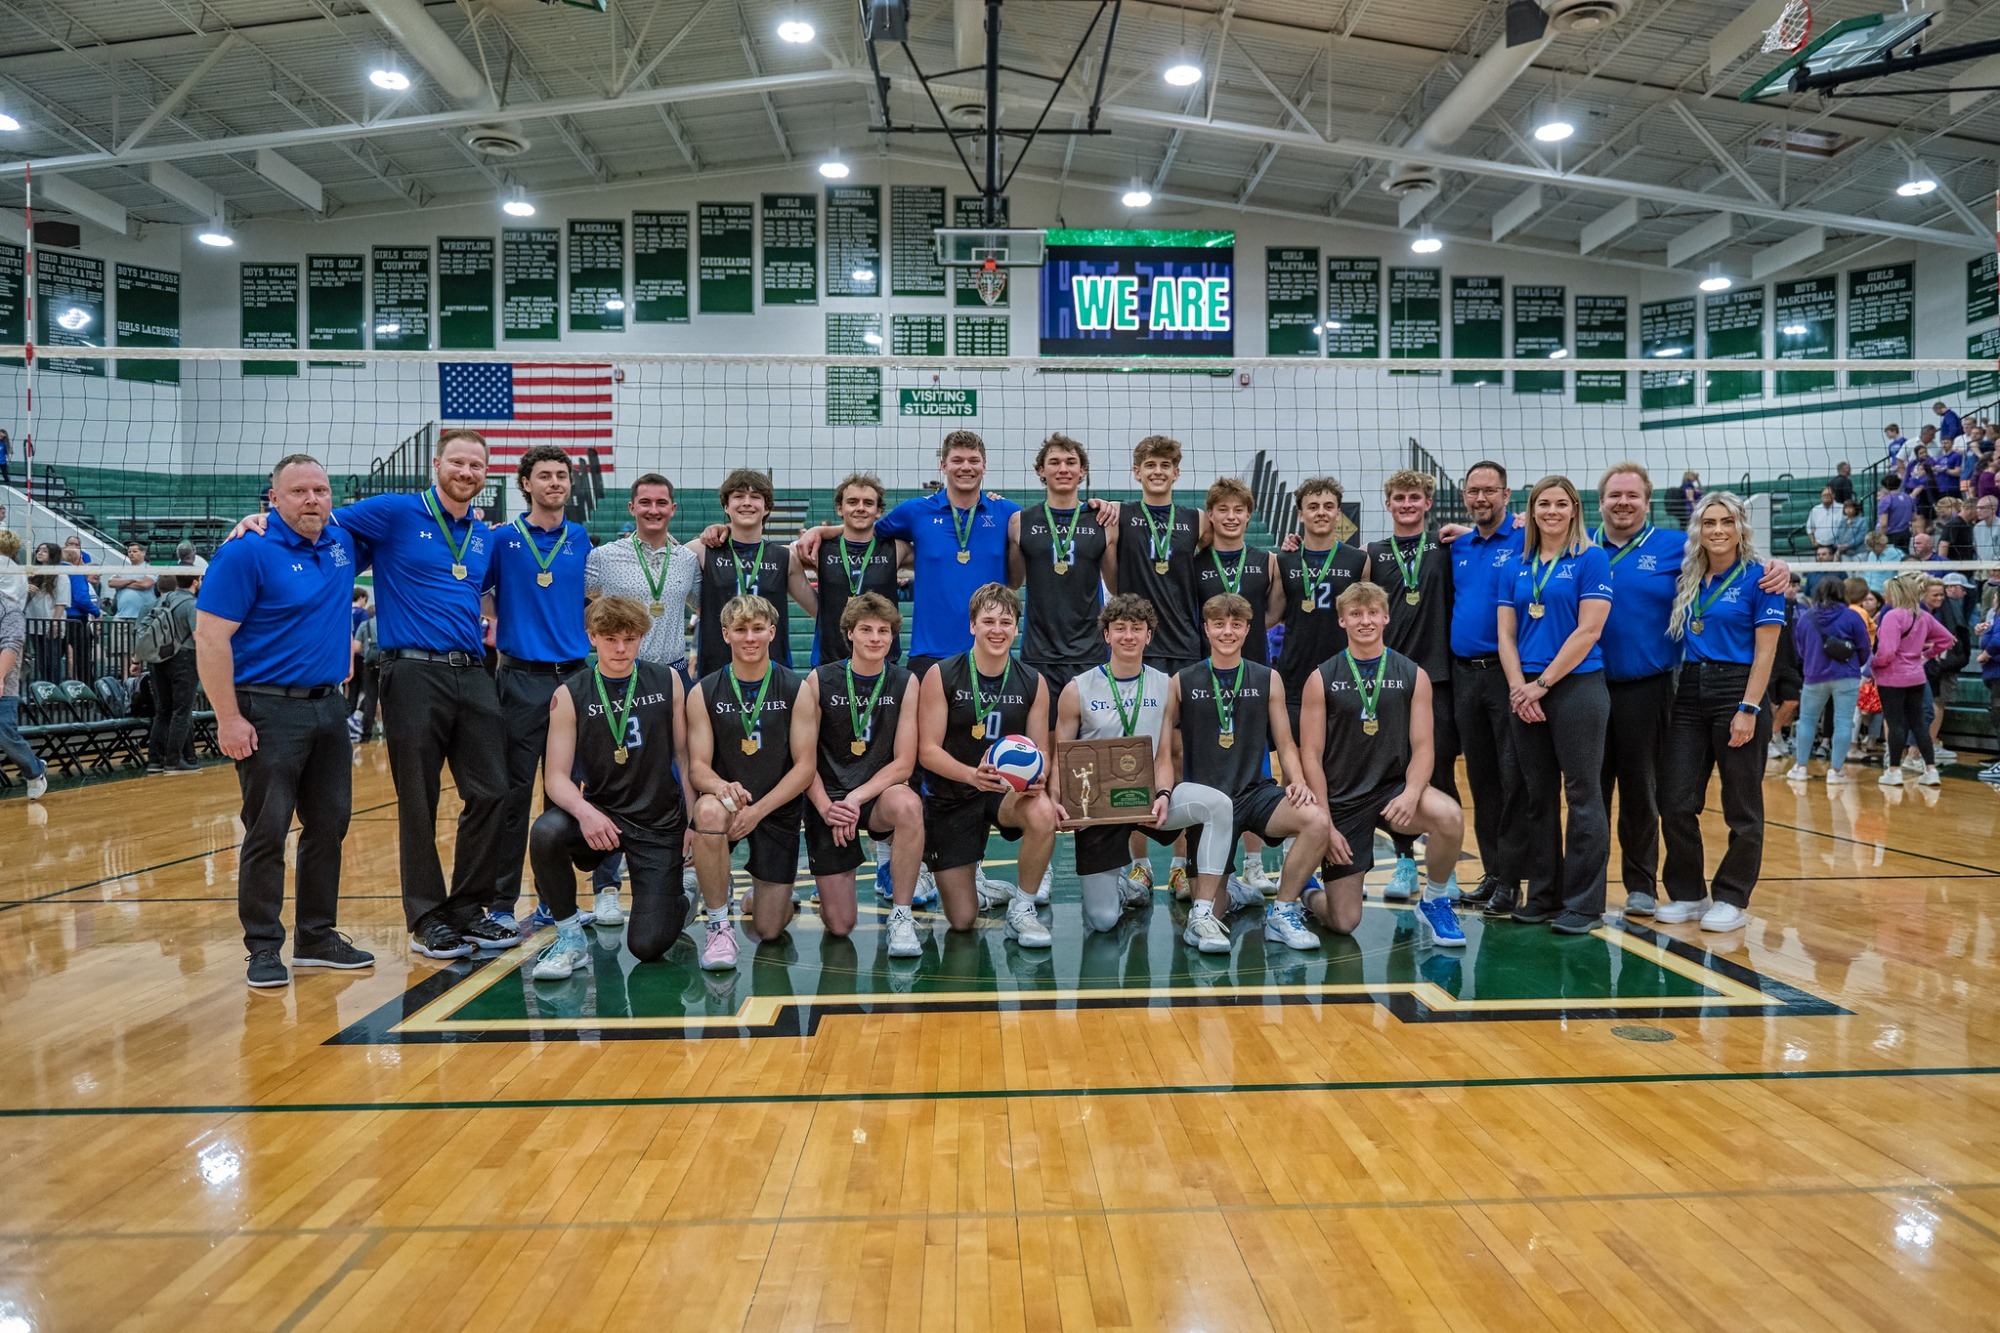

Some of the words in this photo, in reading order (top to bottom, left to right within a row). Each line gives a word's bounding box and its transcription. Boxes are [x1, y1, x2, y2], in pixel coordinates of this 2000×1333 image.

[834, 189, 872, 198] REGIONAL
[778, 198, 800, 208] GIRLS
[701, 207, 719, 216] BOYS
[723, 207, 751, 216] TENNIS
[764, 209, 816, 218] BASKETBALL
[635, 215, 657, 224] GIRLS
[660, 215, 687, 224] SOCCER
[574, 223, 618, 233] BASEBALL
[504, 232, 527, 241] GIRLS
[531, 232, 559, 241] TRACK
[442, 241, 491, 251] WRESTLING
[375, 250, 399, 260] GIRLS
[402, 250, 428, 260] CROSS
[1282, 251, 1304, 260] GIRLS
[38, 252, 58, 264] OHIO
[61, 256, 97, 270] DIVISION
[313, 259, 334, 268] BOYS
[338, 259, 359, 268] GOLF
[382, 261, 420, 271] COUNTRY
[700, 257, 751, 266] CHEERLEADING
[1269, 262, 1318, 270] VOLLEYBALL
[1330, 262, 1350, 270] BOYS
[1354, 262, 1378, 270] CROSS
[38, 263, 57, 273] GIRLS
[57, 266, 78, 277] TRACK
[86, 270, 103, 280] FIELD
[117, 266, 138, 277] BOYS
[140, 269, 179, 284] LACROSSE
[244, 267, 264, 277] BOYS
[268, 267, 296, 277] TRACK
[1335, 272, 1372, 280] COUNTRY
[1395, 271, 1435, 280] SOFTBALL
[1867, 269, 1894, 282] GIRLS
[1972, 264, 1992, 278] BOYS
[53, 275, 70, 284] STATE
[71, 278, 104, 289] RUNNER-UP
[1467, 279, 1489, 287] BOYS
[1855, 279, 1906, 295] SWIMMING
[1516, 288, 1540, 297] GIRLS
[1542, 288, 1562, 297] GOLF
[1795, 282, 1817, 293] BOYS
[1455, 289, 1499, 297] SWIMMING
[1708, 295, 1729, 305] GIRLS
[1733, 290, 1762, 302] TENNIS
[1072, 276, 1139, 330] WE
[1150, 277, 1230, 331] ARE
[1577, 299, 1594, 307] BOYS
[1597, 299, 1626, 307] BOWLING
[1777, 290, 1836, 307] BASKETBALL
[1643, 305, 1662, 316] BOYS
[1666, 301, 1694, 312] SOCCER
[117, 321, 140, 332] GIRLS
[142, 325, 179, 338] LACROSSE
[1577, 332, 1596, 340] GIRLS
[1596, 332, 1624, 340] BOWLING
[1971, 341, 1992, 354] GIRLS
[911, 391, 966, 401] VISITING
[905, 404, 973, 414] STUDENTS
[1131, 517, 1148, 527] ST.
[1149, 521, 1190, 531] XAER
[1031, 525, 1048, 535] ST.
[1050, 525, 1096, 535] XAIER
[716, 557, 733, 568] ST.
[827, 555, 843, 565] ST.
[1202, 569, 1218, 580] ST.
[1310, 582, 1332, 609] 12
[1331, 680, 1350, 692] ST.
[955, 690, 974, 701] ST.
[978, 691, 1024, 705] XAVIER
[1192, 688, 1210, 700] ST.
[588, 703, 606, 716] ST
[612, 693, 666, 713] XVIER
[830, 695, 849, 706] ST.
[855, 695, 895, 707] XAIER
[1091, 700, 1109, 711] ST.
[1113, 698, 1158, 710] AVER
[716, 701, 735, 714] ST.
[738, 700, 788, 714] XAVIER
[626, 715, 643, 749] 3
